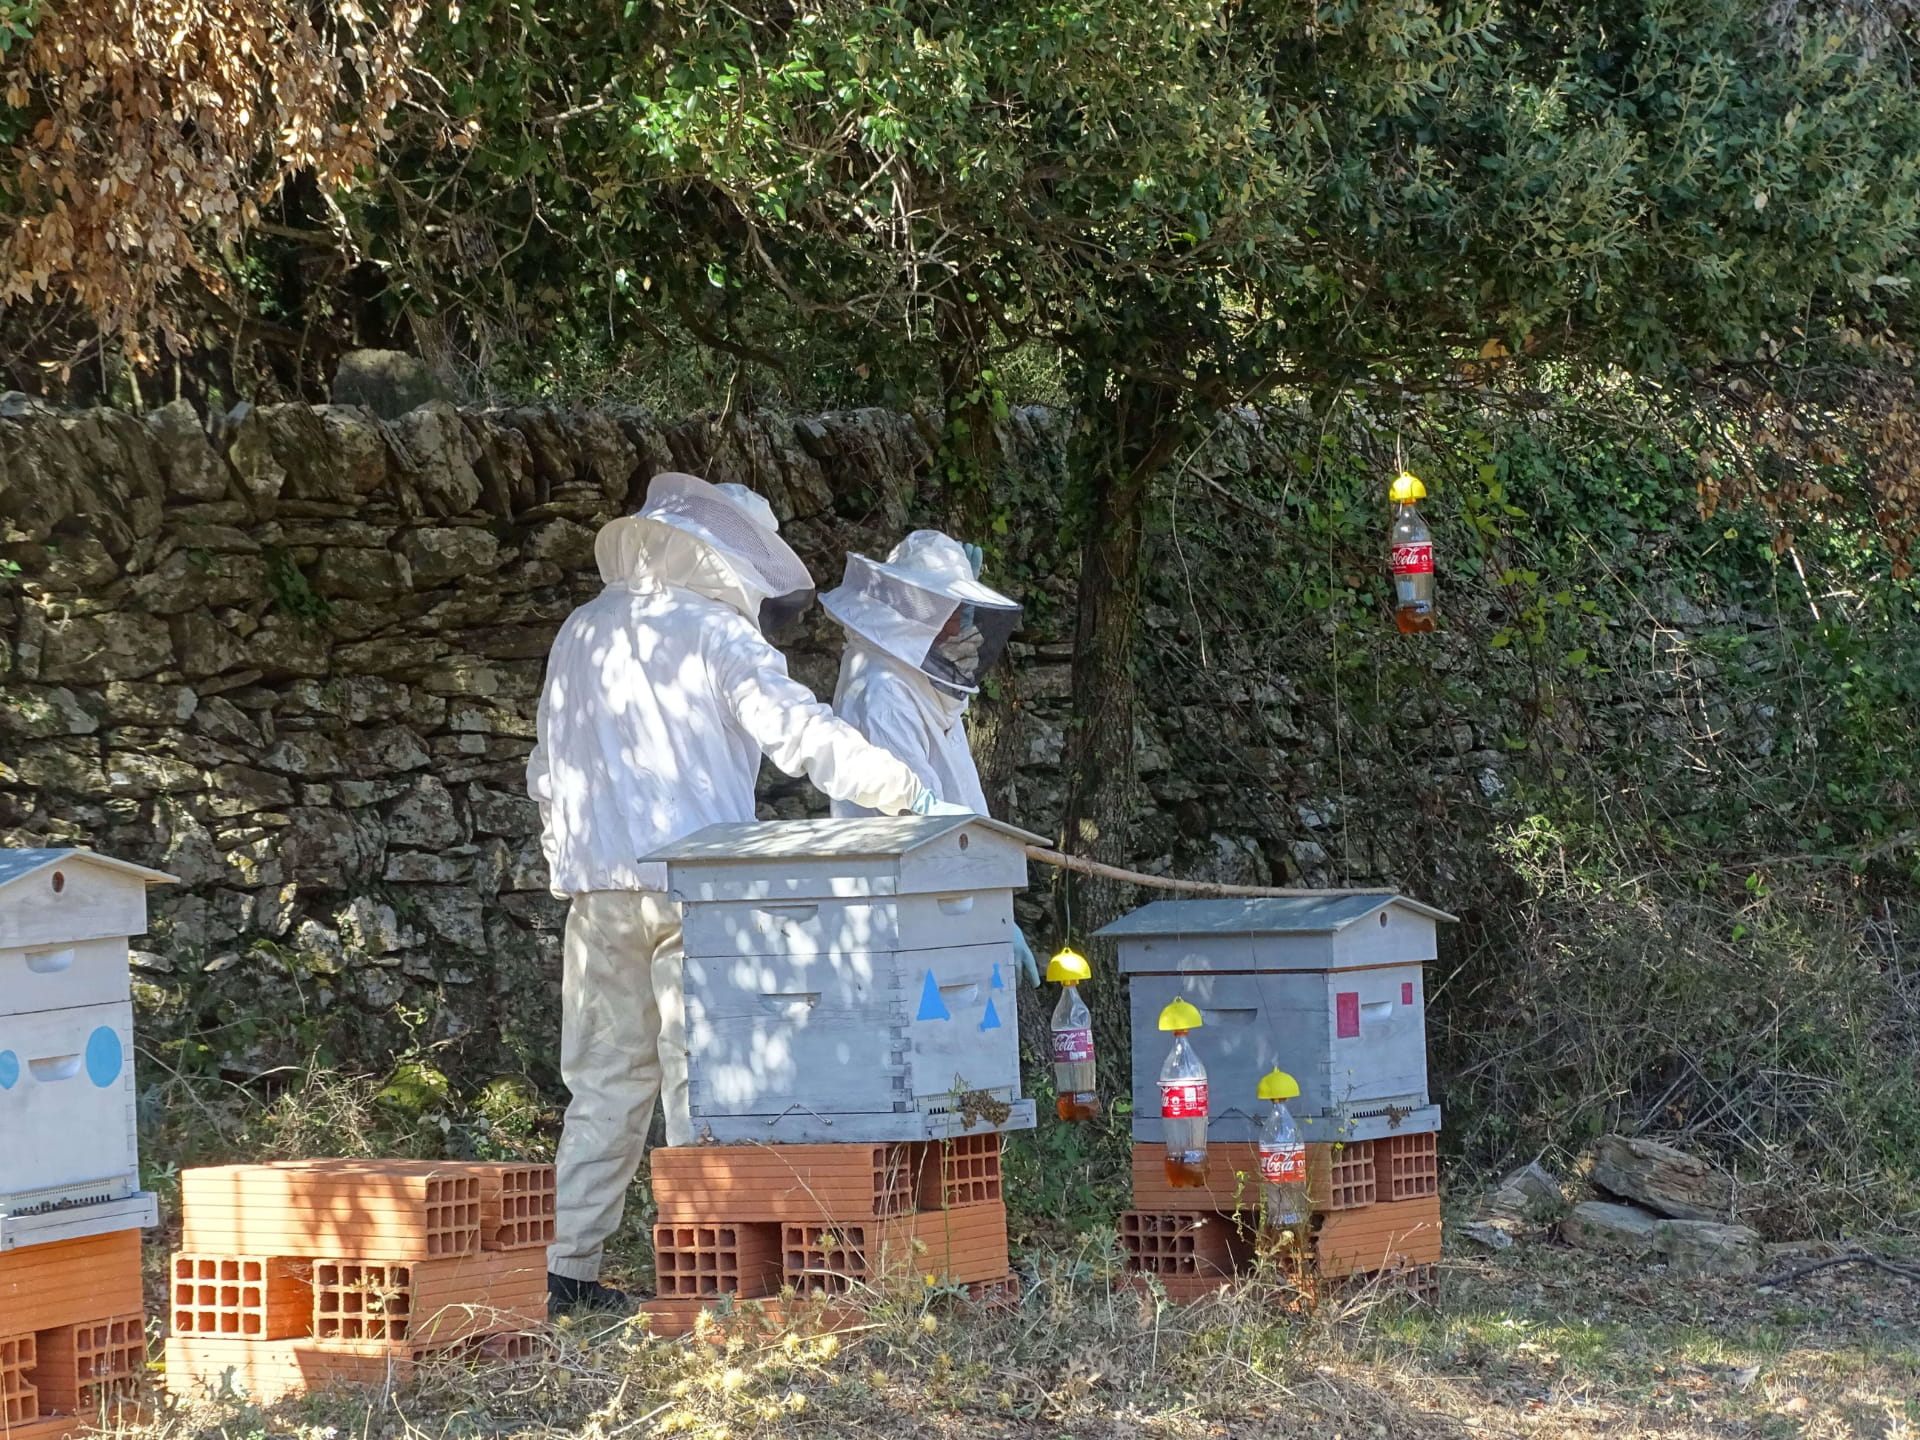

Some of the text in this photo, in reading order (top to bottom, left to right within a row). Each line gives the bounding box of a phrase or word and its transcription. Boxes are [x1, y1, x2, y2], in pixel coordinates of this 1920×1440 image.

[1395, 546, 1419, 565] Cola
[1054, 1032, 1075, 1051] Cola
[1267, 1151, 1295, 1173] Cola
